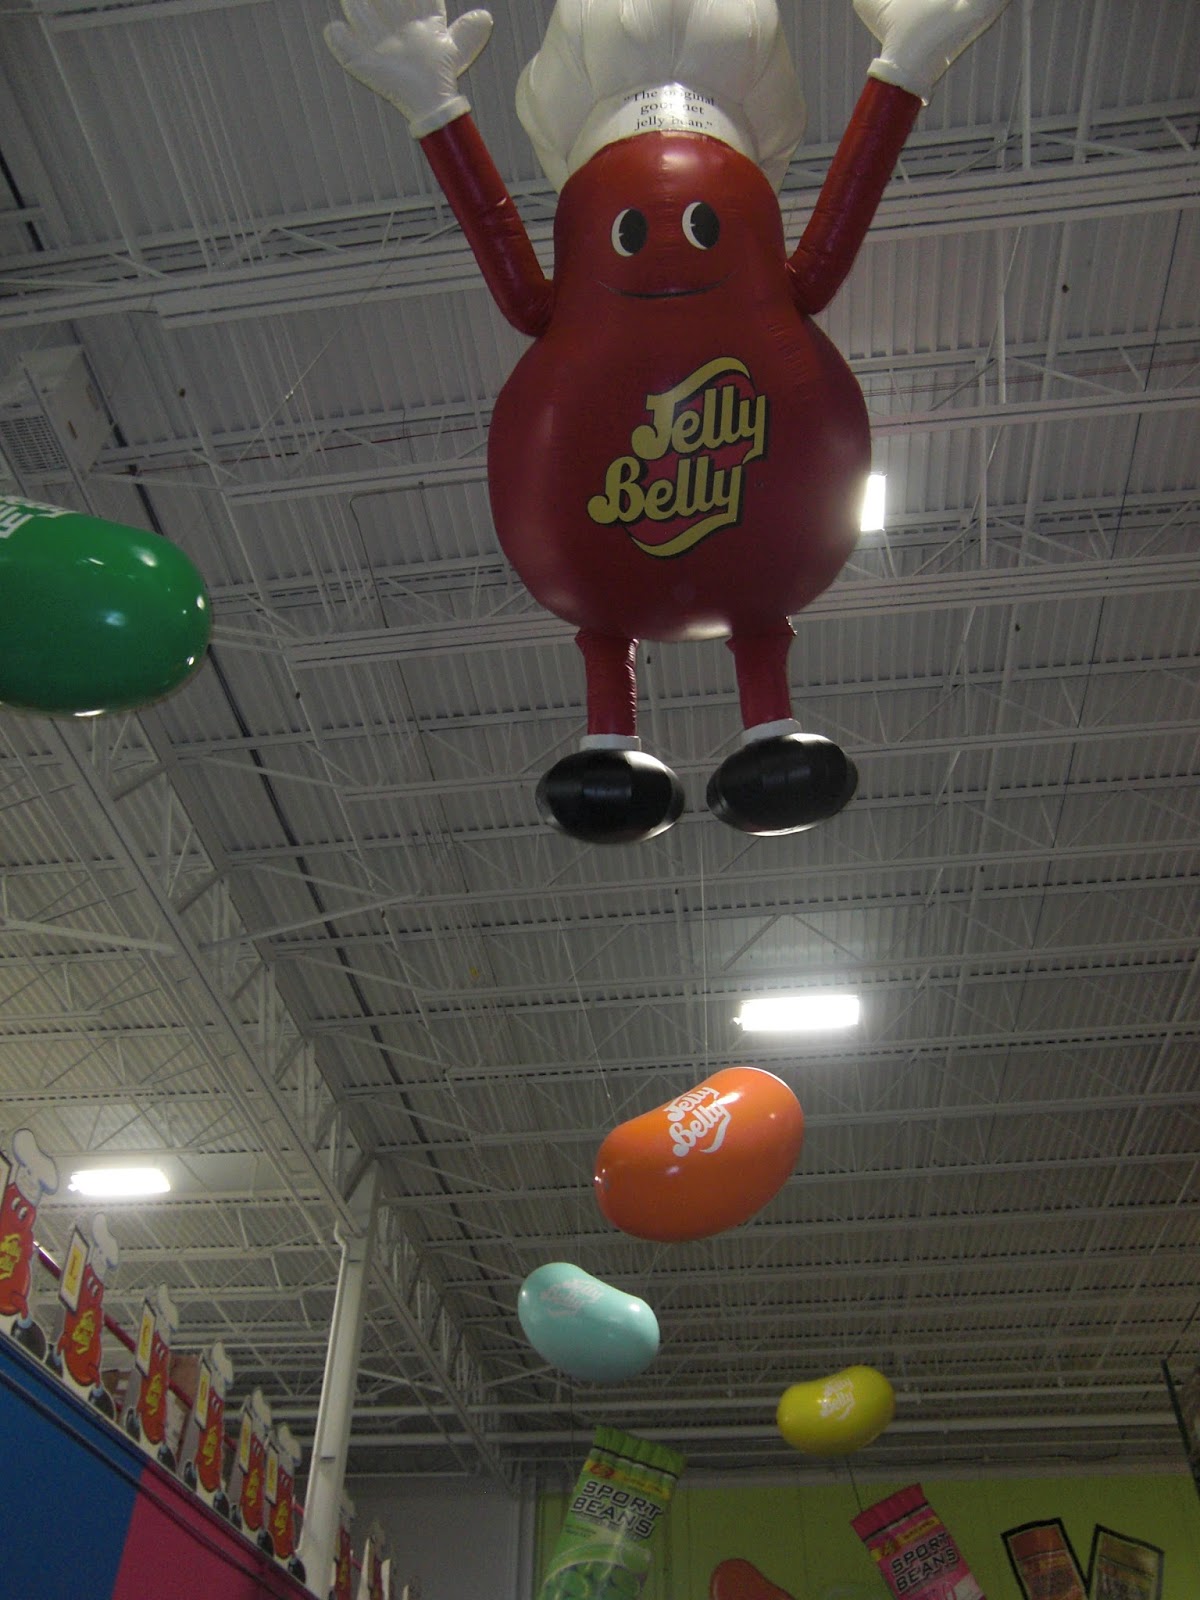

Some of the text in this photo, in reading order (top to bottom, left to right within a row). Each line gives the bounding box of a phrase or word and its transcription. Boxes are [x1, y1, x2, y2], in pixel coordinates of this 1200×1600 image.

[635, 116, 665, 131] jelly
[631, 356, 767, 465] Jelly
[587, 455, 743, 557] Belly
[663, 1086, 720, 1122] Jelly
[669, 1103, 731, 1157] Belly
[571, 1496, 654, 1536] BEANS
[582, 1480, 663, 1520] SPORT
[891, 1532, 949, 1574] SPORT
[895, 1548, 957, 1591] BEANS
